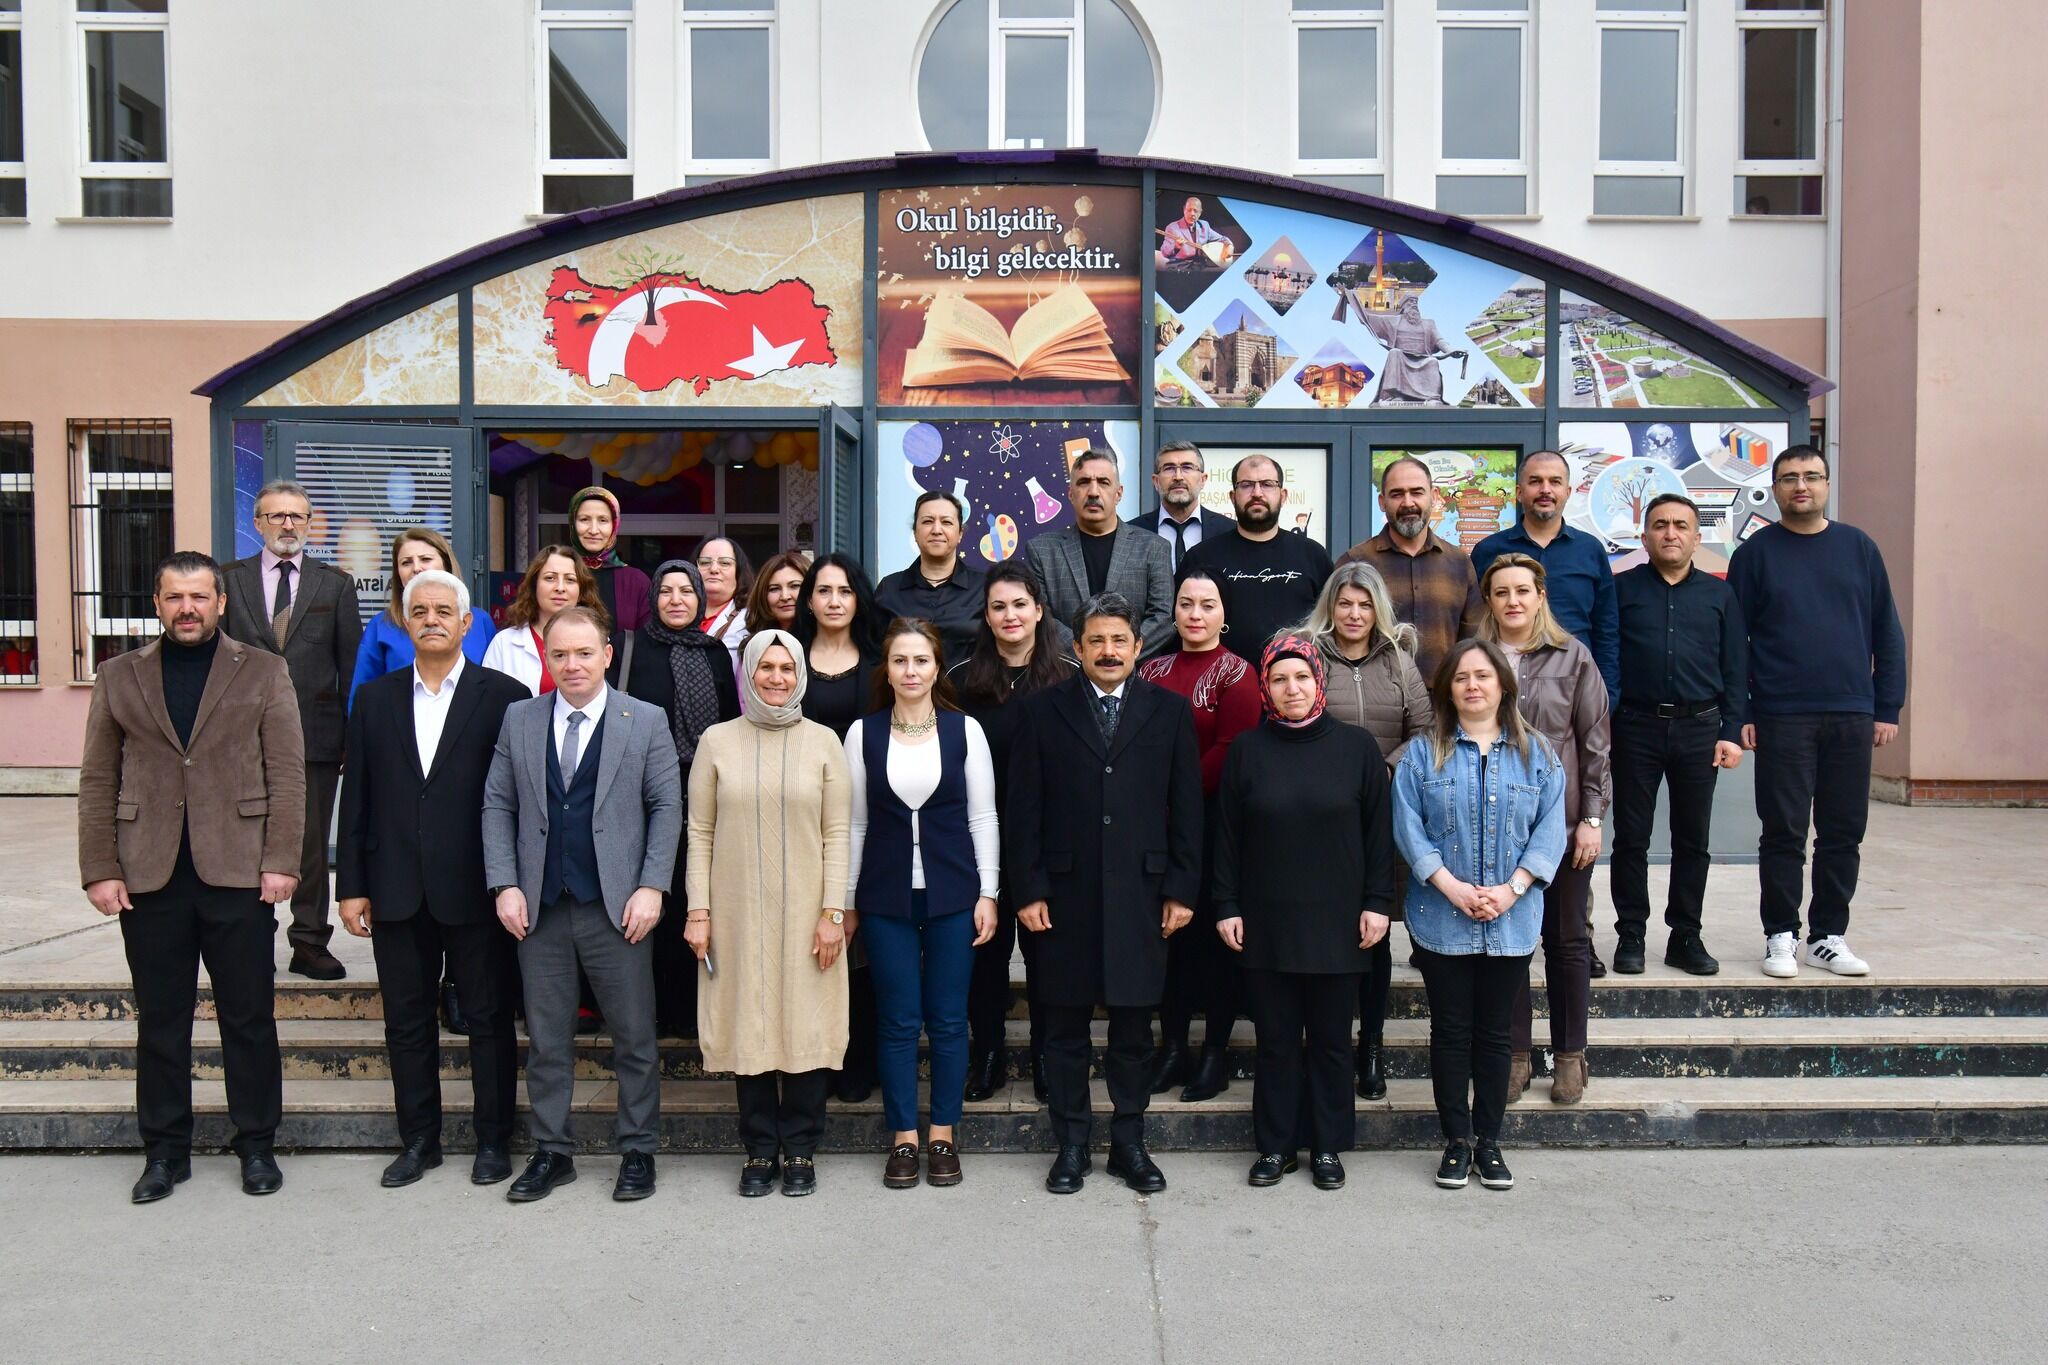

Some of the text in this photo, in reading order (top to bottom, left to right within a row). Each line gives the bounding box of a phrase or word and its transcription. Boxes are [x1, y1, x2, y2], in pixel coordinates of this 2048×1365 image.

[896, 207, 1063, 238] Okul bilgidir,
[935, 246, 1121, 276] bilgi gelecektir.
